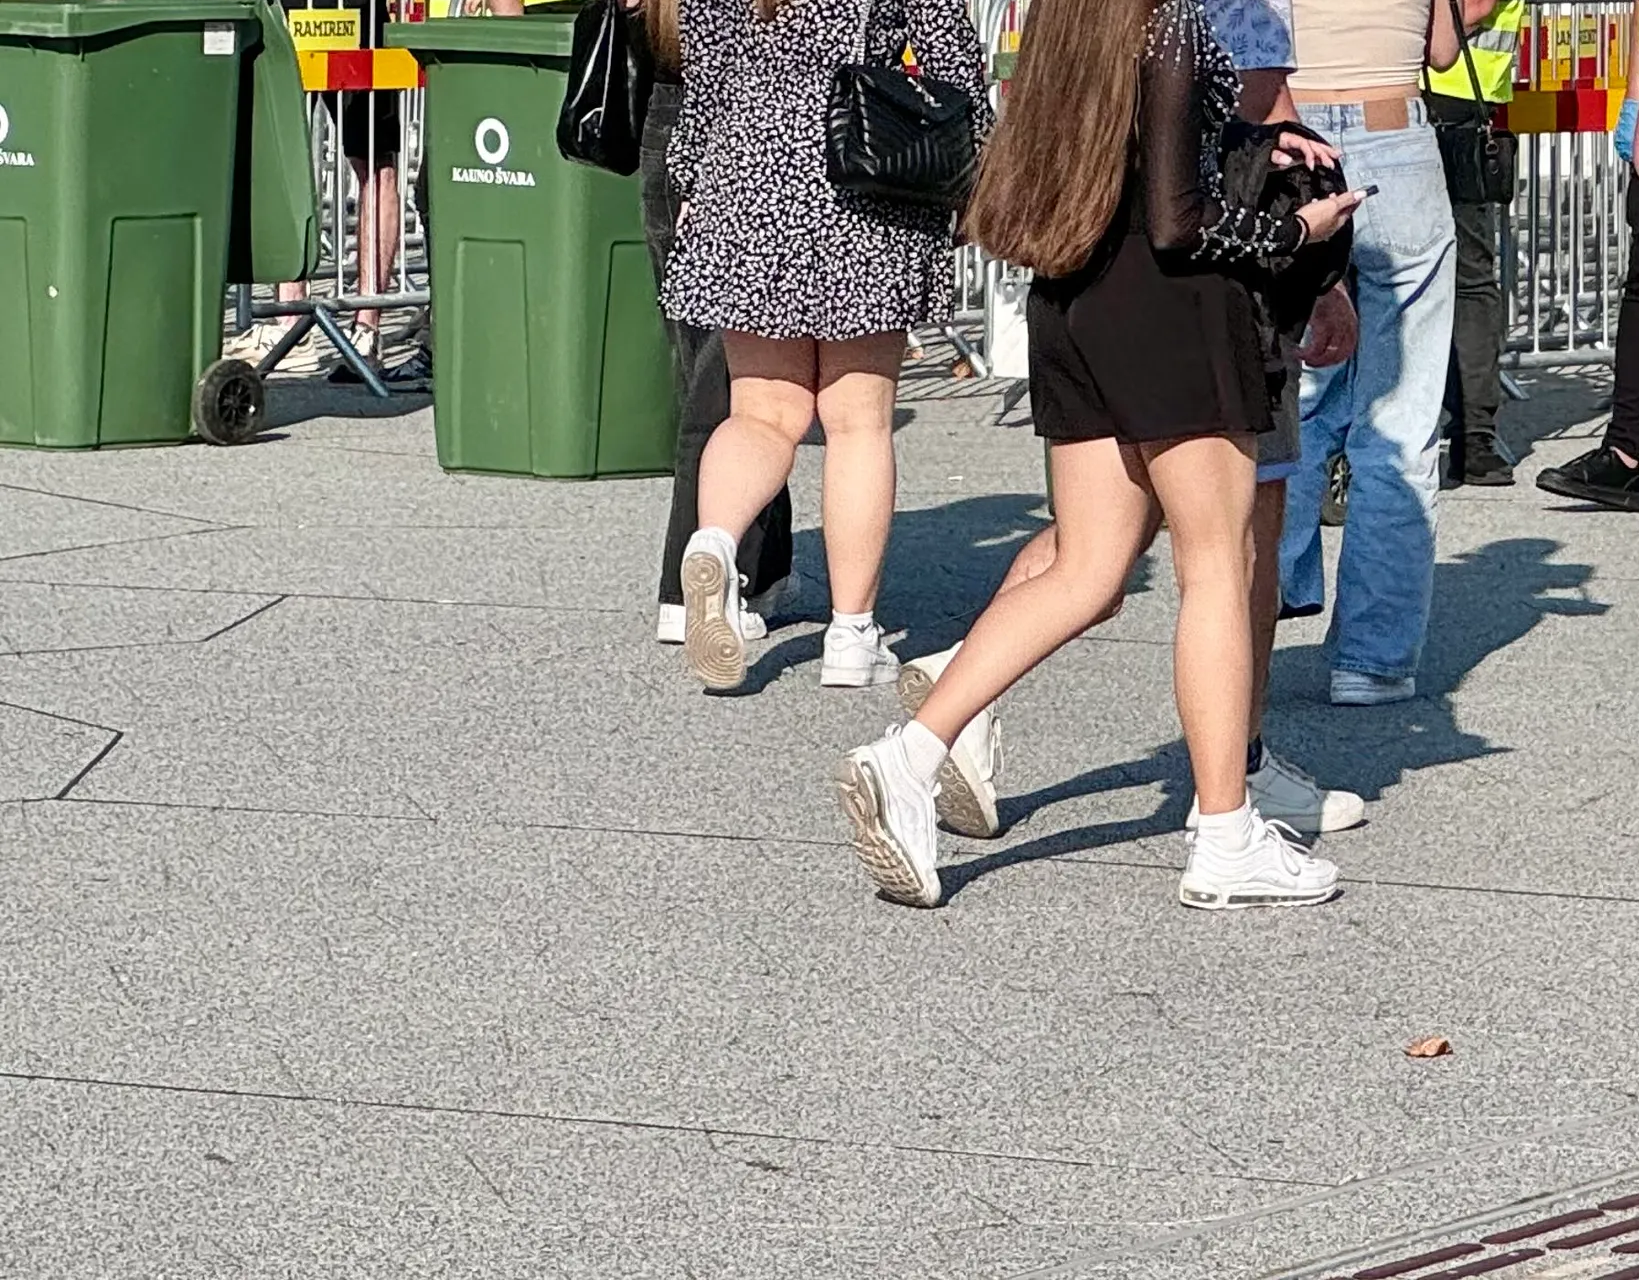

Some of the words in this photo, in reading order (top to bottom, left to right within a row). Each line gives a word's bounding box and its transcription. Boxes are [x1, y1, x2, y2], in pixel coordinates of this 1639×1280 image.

[293, 20, 356, 38] RAMIRENT
[451, 166, 495, 184] KAUNO
[494, 166, 536, 187] ŠVARA
